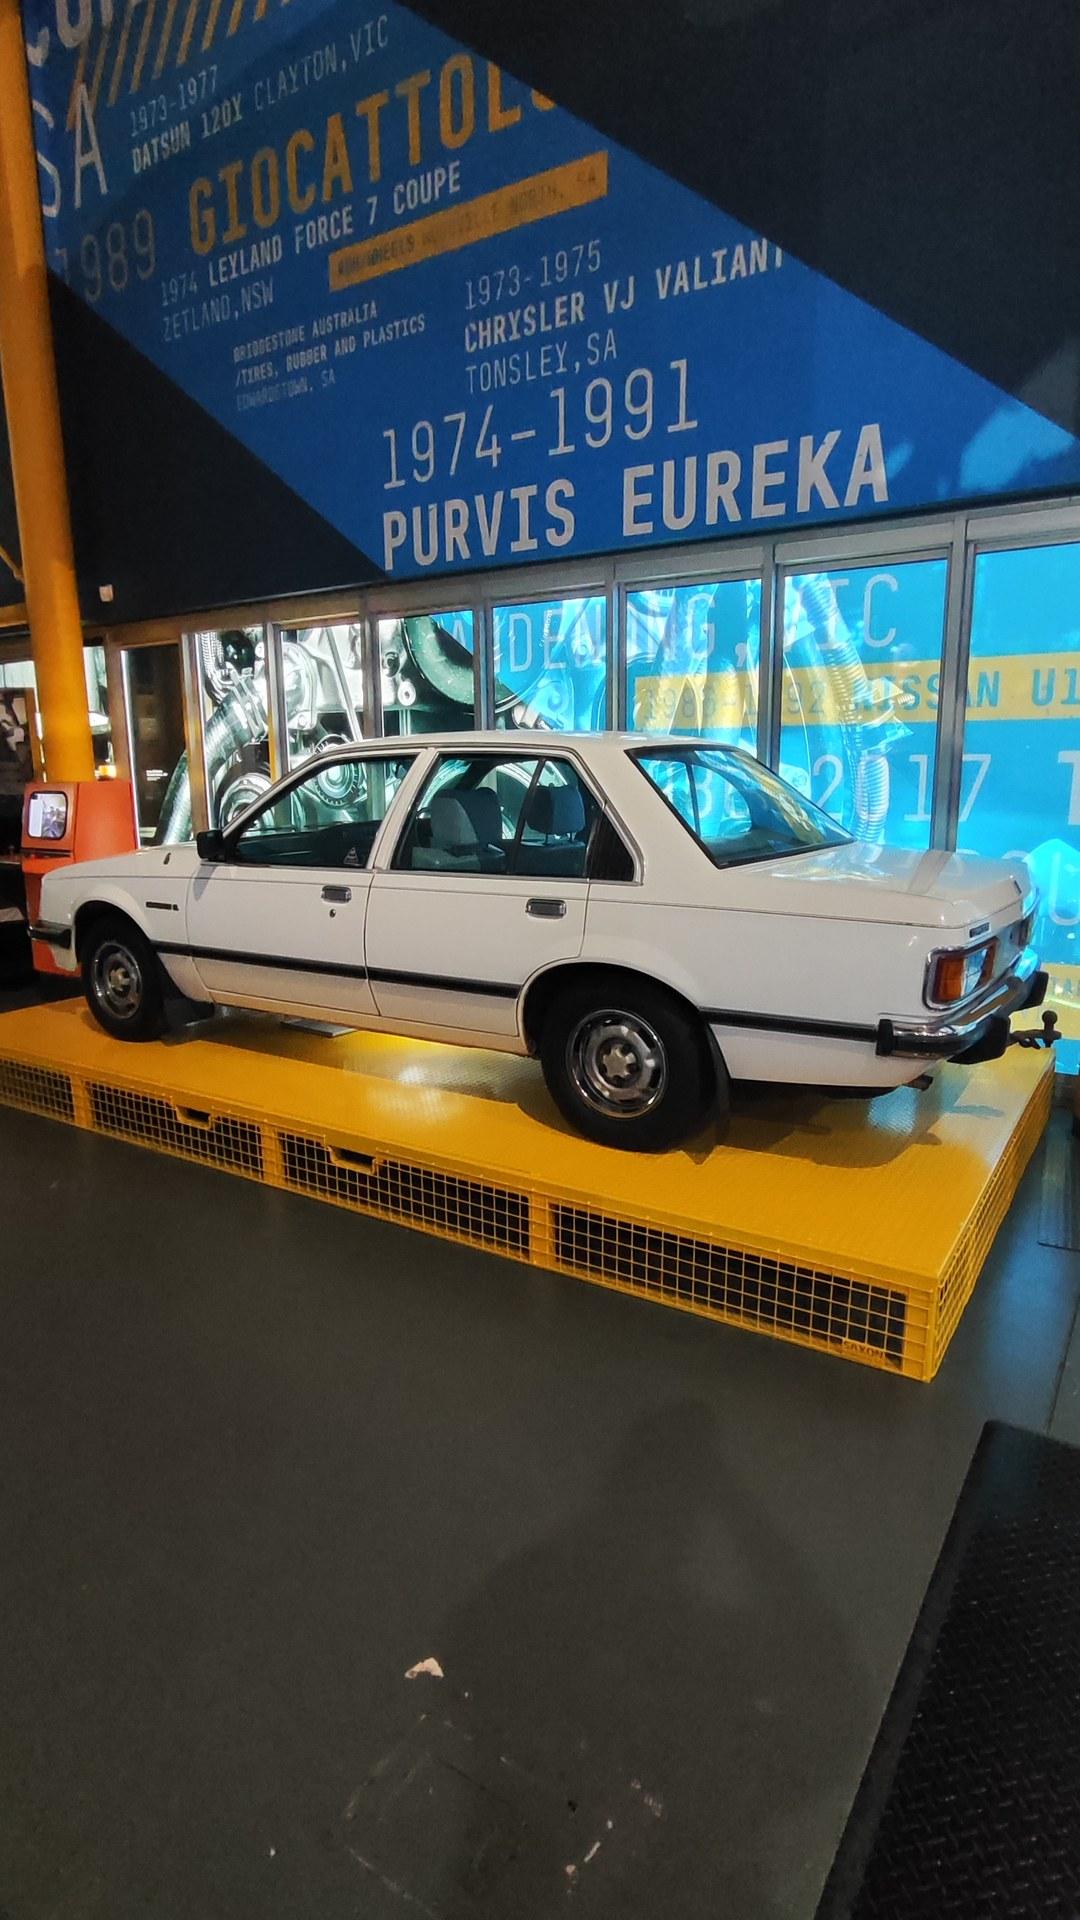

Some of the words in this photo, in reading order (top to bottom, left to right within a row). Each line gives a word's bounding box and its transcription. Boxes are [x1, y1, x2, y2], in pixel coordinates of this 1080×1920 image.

[130, 64, 218, 137] 1973-1977
[131, 120, 192, 175] DATSUN
[201, 92, 243, 139] 120Y
[188, 54, 556, 256] GIOCATTOL
[161, 270, 199, 307] 1974
[208, 234, 283, 287] LEYLAND
[294, 205, 354, 255] FORCE
[366, 195, 378, 226] 7
[393, 160, 461, 216] COUPE
[464, 239, 602, 311] 1973-1975
[464, 291, 586, 353] CHRYSLER
[603, 276, 636, 315] VJ
[233, 324, 306, 363] BRIDGESTONE
[312, 299, 378, 338] AUSTRALIA
[286, 343, 328, 373] RUBBER
[335, 335, 357, 358] AND
[363, 313, 426, 349] PLASTICS
[383, 358, 699, 490] 1974-1991
[383, 479, 577, 572] PURVIS
[622, 422, 890, 538] EUREKA
